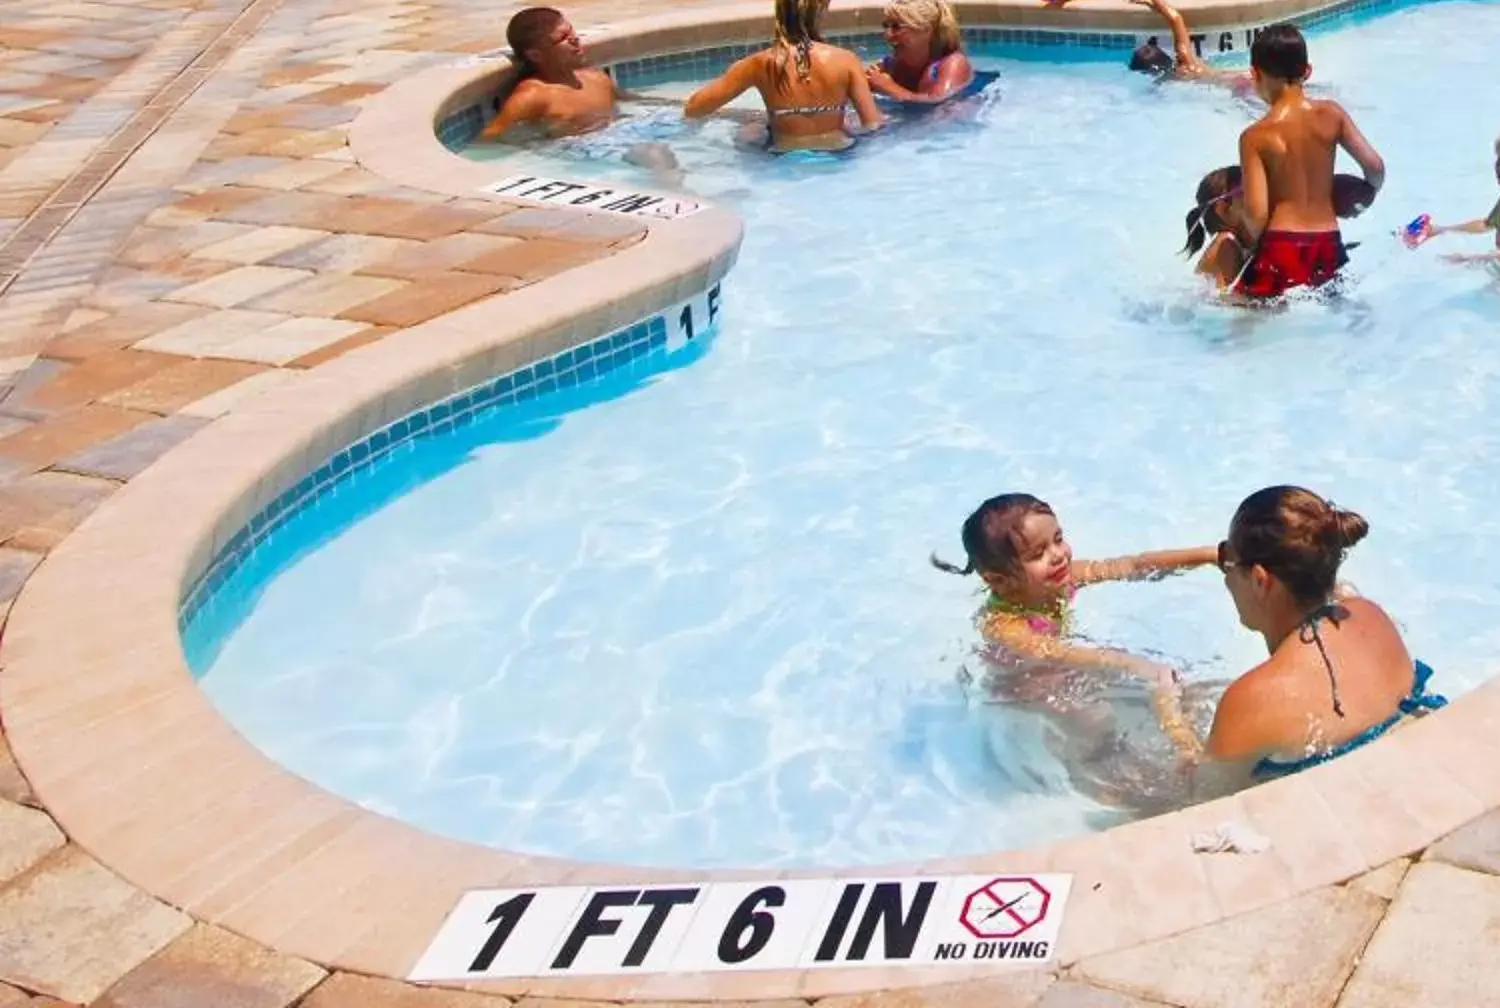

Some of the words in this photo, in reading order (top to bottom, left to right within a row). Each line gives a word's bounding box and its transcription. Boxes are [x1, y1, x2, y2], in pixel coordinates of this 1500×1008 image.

[520, 181, 588, 200] FT
[467, 893, 536, 973] 1
[550, 888, 701, 970] FT
[717, 886, 785, 965] 6
[813, 882, 938, 962] IN
[934, 943, 967, 961] NO
[973, 942, 1049, 959] DIVING
